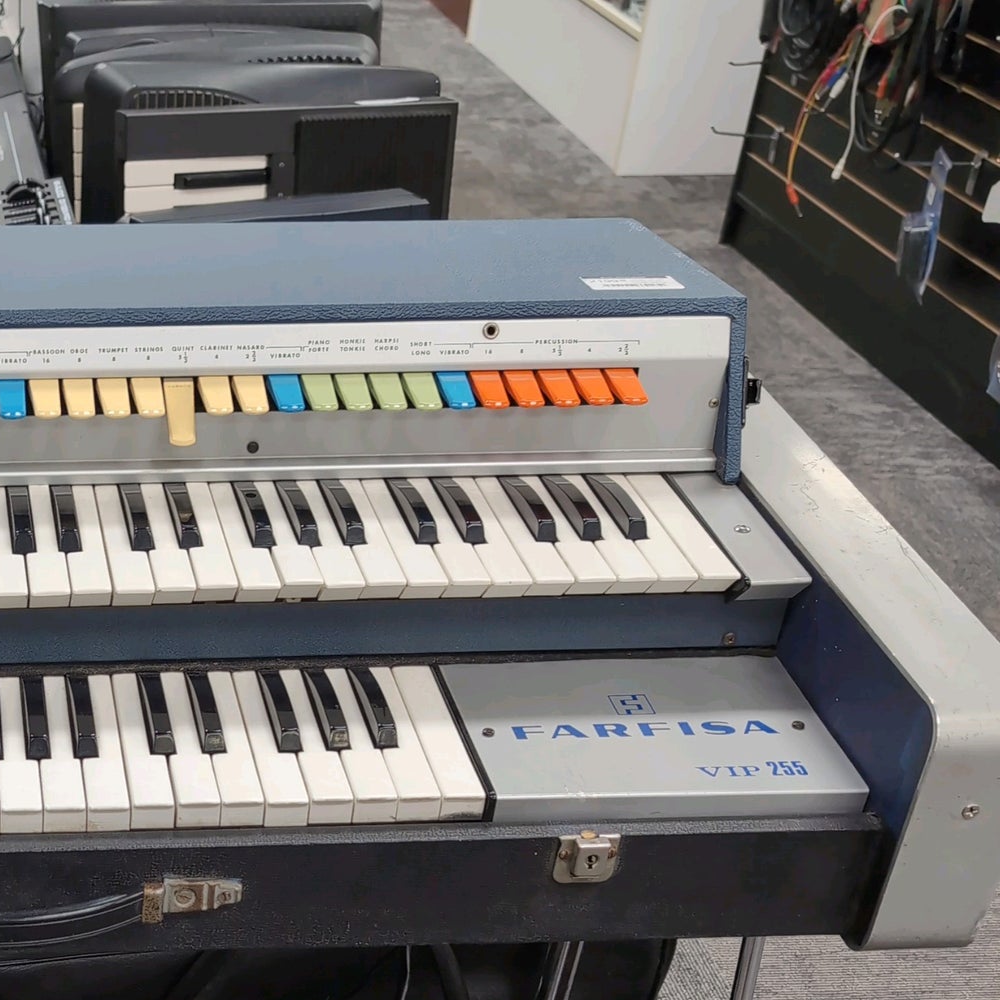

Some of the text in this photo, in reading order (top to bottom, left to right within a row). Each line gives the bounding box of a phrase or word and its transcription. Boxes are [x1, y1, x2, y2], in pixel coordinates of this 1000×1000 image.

[510, 720, 782, 740] FARFISA
[694, 760, 809, 778] VIP 255
